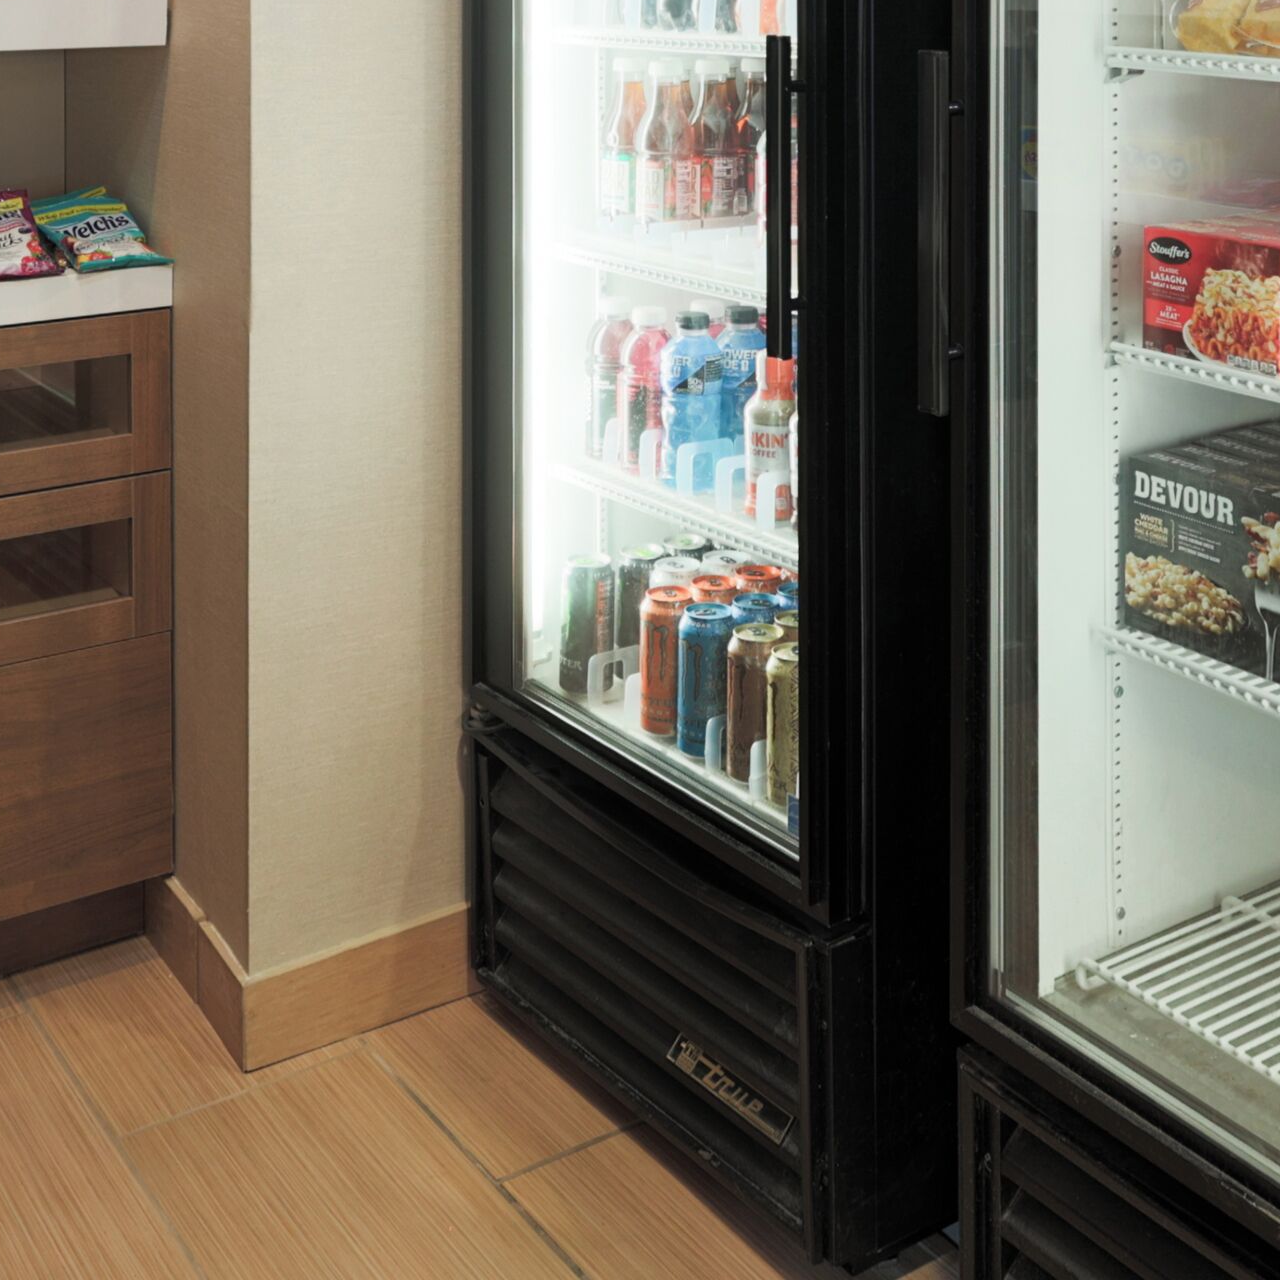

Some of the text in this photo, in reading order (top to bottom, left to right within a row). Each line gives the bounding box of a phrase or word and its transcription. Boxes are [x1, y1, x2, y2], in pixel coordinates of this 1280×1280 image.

[1148, 241, 1190, 260] Stouffer's
[1158, 266, 1180, 275] CLASSIC
[1150, 271, 1188, 286] LASAGNA
[1170, 284, 1186, 293] SAUCE
[1134, 470, 1234, 526] DEVOUR
[1135, 518, 1168, 533] CHEDDAR
